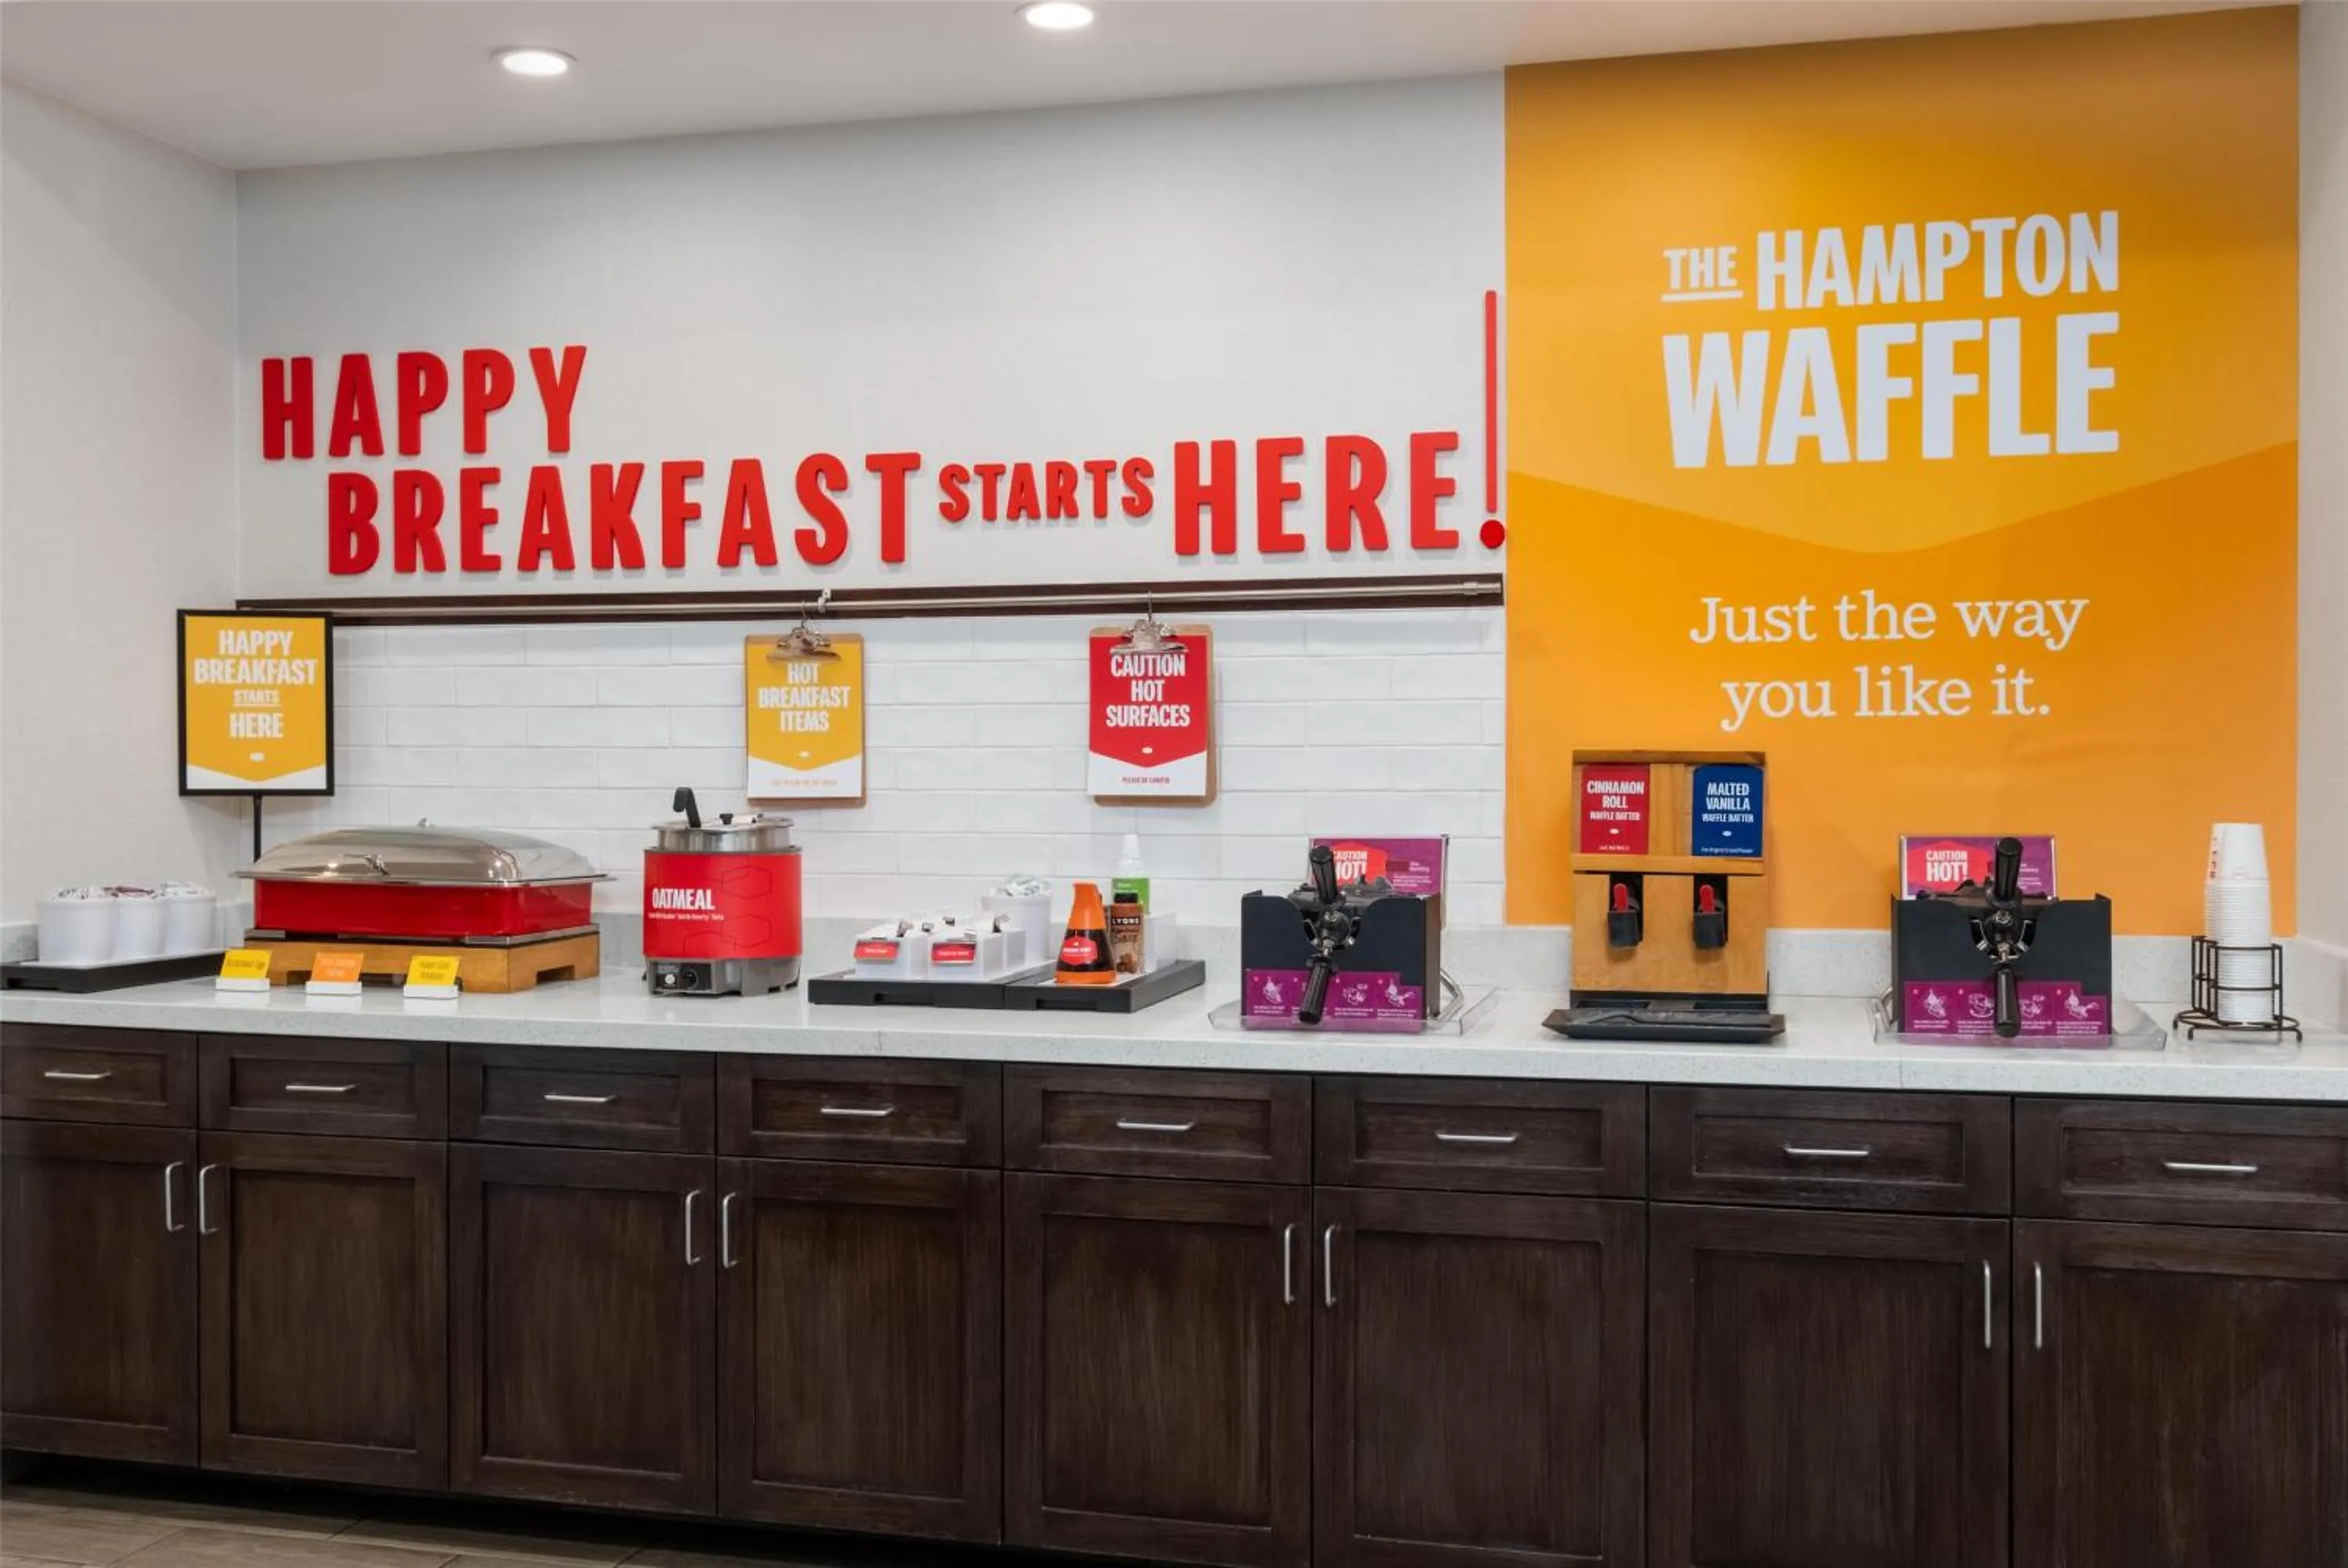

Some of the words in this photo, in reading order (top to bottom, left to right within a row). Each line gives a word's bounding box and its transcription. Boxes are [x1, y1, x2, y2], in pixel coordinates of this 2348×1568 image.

[1662, 246, 1738, 290] THE
[1756, 210, 2119, 311] HAMPTON
[1661, 311, 2120, 468] WAFFLE
[261, 345, 587, 460] HAPPY
[327, 452, 921, 575] BREAKFAST
[938, 457, 1154, 523] STARTS
[1174, 290, 1506, 556] HERE!
[1689, 596, 1818, 644] Just
[1833, 588, 1938, 642] the
[1952, 598, 2091, 652] way
[218, 629, 294, 656] HAPPY
[194, 658, 319, 685] BREAKFAST
[787, 663, 820, 685] HOT
[1111, 653, 1187, 677] CAUTION
[233, 689, 279, 704] STARTS
[758, 686, 851, 708] BREAKFAST
[1130, 679, 1165, 702] HOT
[1719, 679, 1837, 733] you
[1853, 664, 1973, 718] like
[1990, 663, 2051, 717] it.
[229, 713, 284, 739] HERE
[780, 710, 830, 733] ITEMS
[1106, 703, 1190, 727] SURFACES
[1586, 779, 1644, 795] CINNAMON
[1707, 781, 1750, 797] MALTED
[1601, 794, 1629, 809] ROLL
[1705, 797, 1751, 811] VANILLA
[1702, 813, 1727, 823] WAFFLE
[1727, 813, 1755, 823] BATTER
[1925, 850, 1968, 861] CAUTION
[1926, 861, 1968, 883] HOT!
[652, 887, 716, 911] OATMEAL
